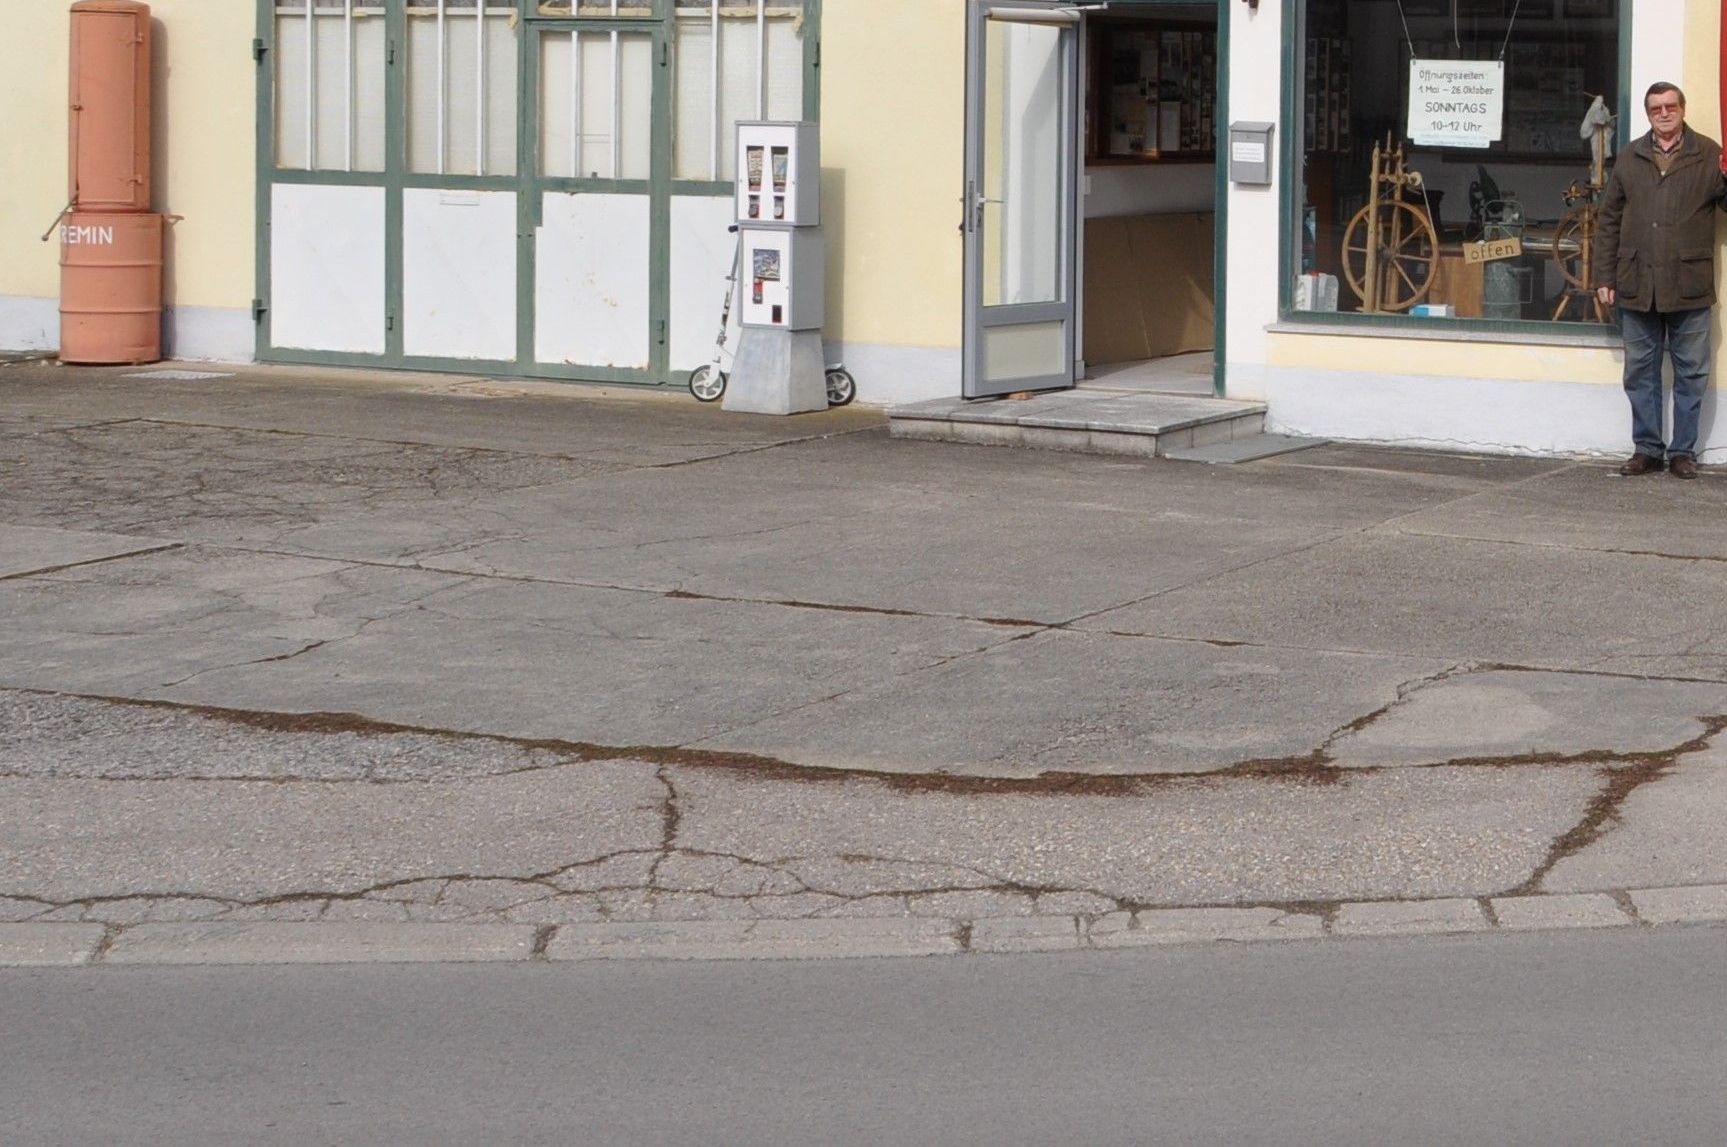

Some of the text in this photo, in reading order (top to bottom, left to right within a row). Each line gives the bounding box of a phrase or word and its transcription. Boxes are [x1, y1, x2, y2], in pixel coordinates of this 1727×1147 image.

[1463, 85, 1494, 95] Oktober
[1425, 102, 1487, 114] SONNTAGS
[1463, 121, 1482, 132] Uhr
[1471, 244, 1514, 260] offen
